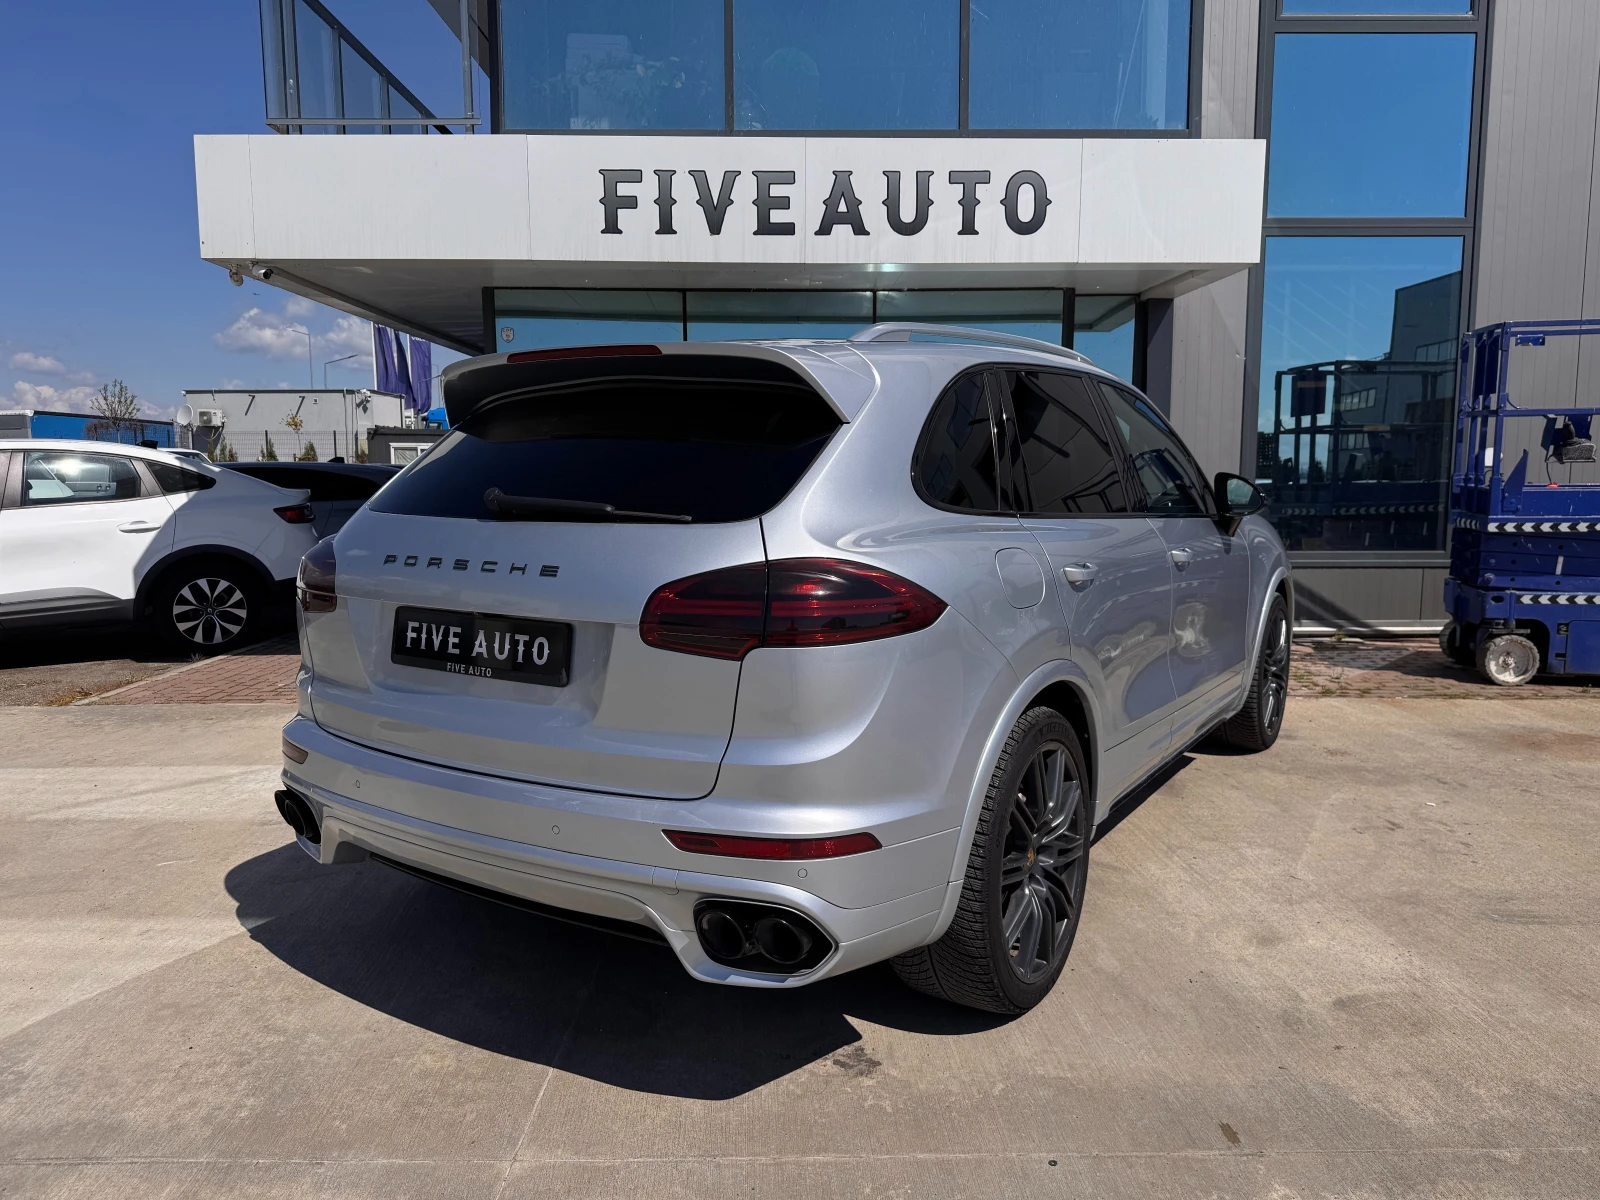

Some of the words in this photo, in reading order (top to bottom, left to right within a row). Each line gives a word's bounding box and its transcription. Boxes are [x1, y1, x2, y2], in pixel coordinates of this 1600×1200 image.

[383, 554, 560, 578] PORSCHE
[406, 620, 462, 655] FIVE
[471, 629, 550, 666] AUTO
[446, 662, 465, 674] FIVE
[468, 665, 492, 677] AUTO
